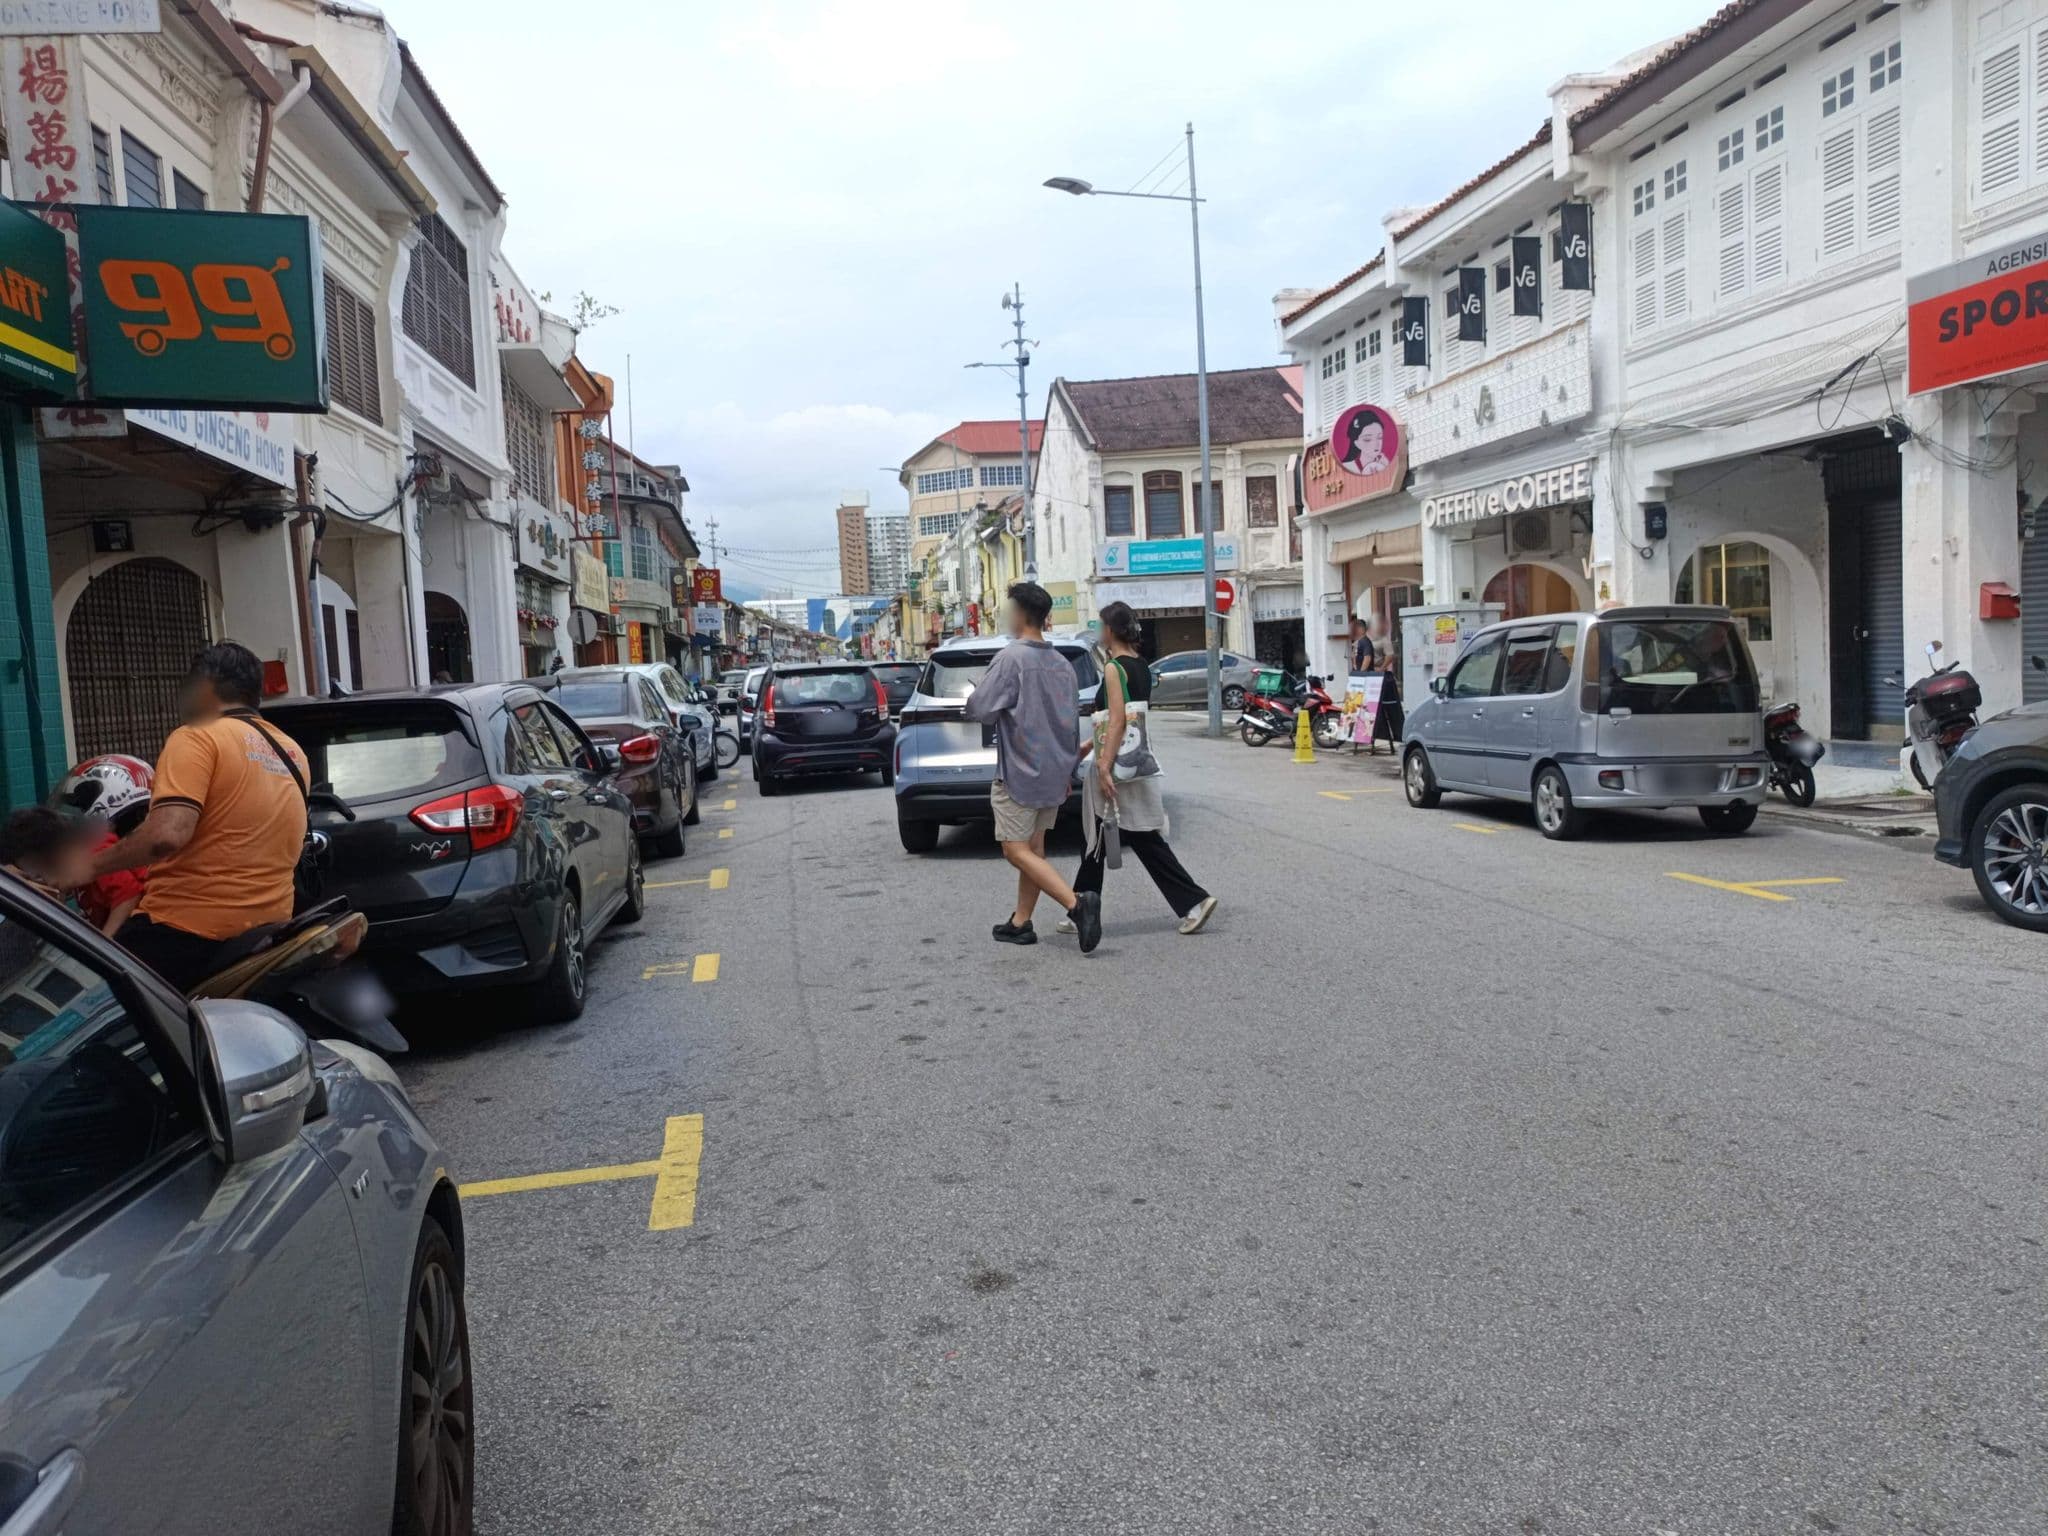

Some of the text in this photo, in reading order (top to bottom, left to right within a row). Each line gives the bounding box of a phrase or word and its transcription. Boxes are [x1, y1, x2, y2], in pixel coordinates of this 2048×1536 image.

[99, 257, 296, 361] 99
[194, 411, 250, 462] GINSENG
[255, 435, 285, 477] HONG
